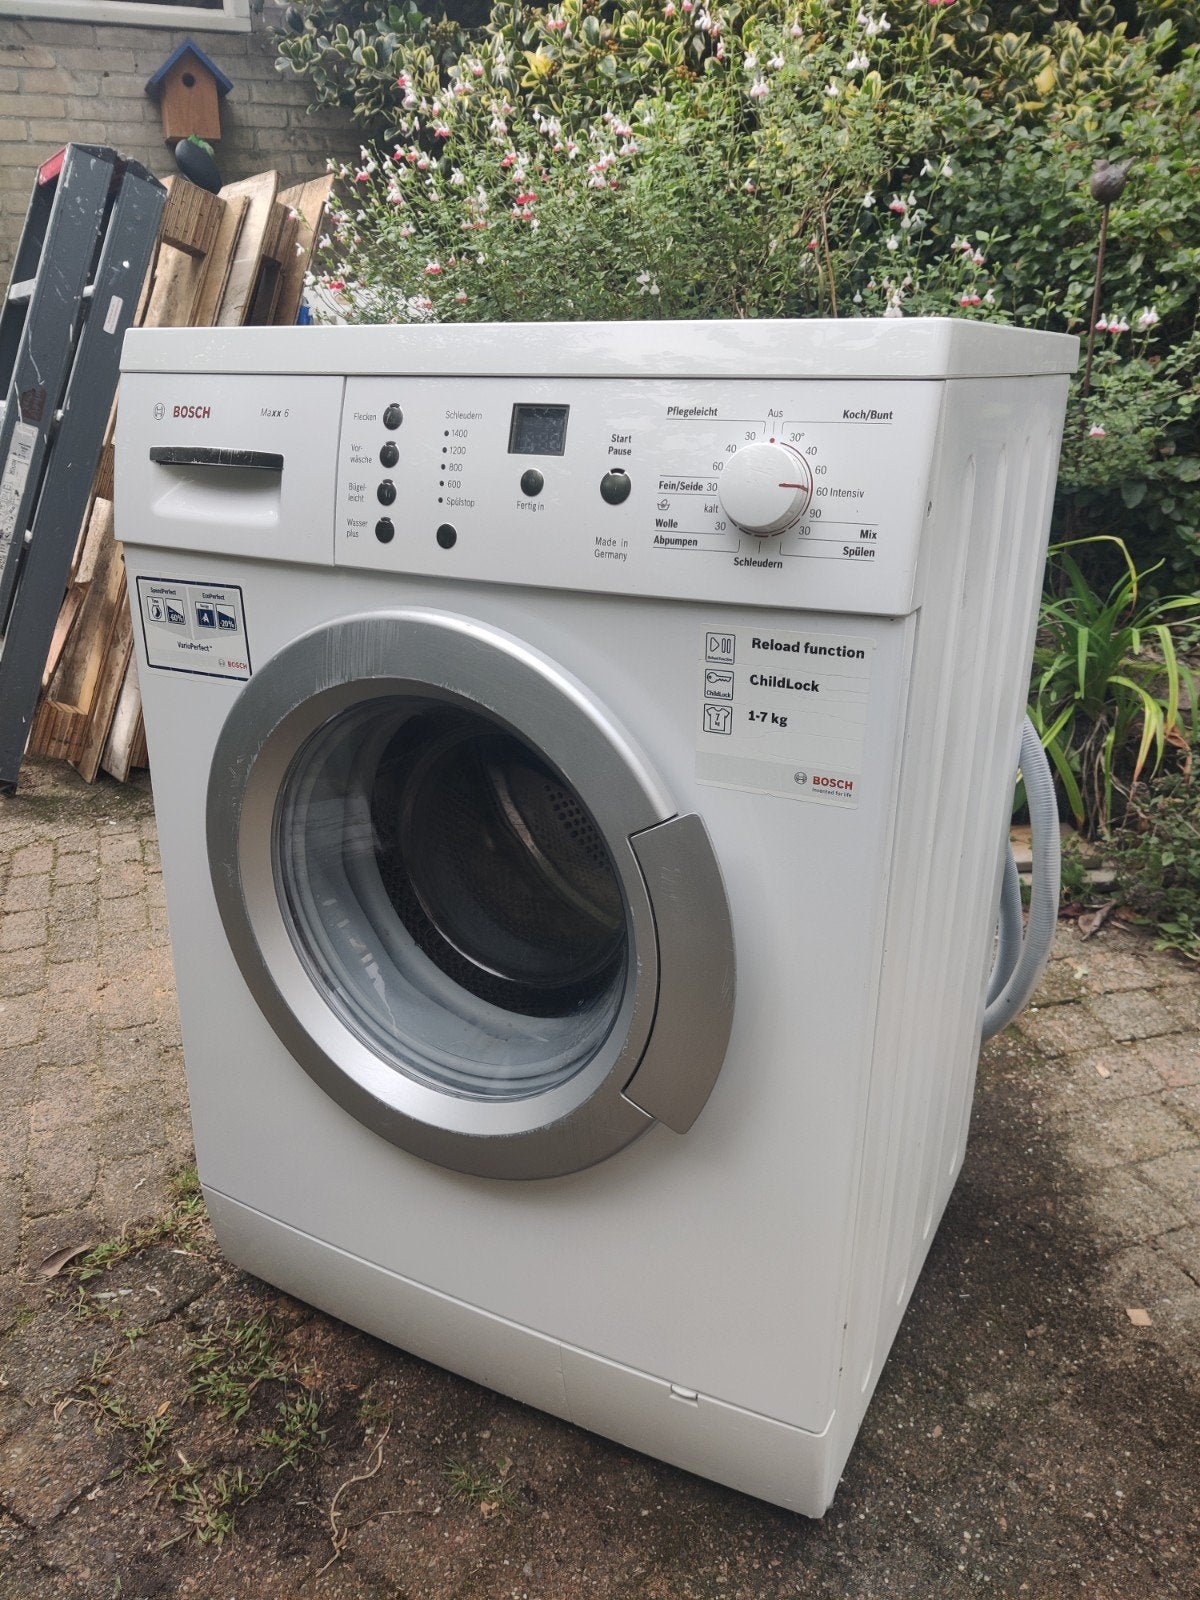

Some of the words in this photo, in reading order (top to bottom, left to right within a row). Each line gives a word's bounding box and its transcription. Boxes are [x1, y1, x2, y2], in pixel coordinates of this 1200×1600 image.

[172, 405, 211, 419] BOSCH
[260, 407, 282, 417] Maxx
[284, 408, 290, 417] 6
[353, 412, 377, 421] Flecken
[445, 410, 483, 420] Schleudern
[667, 406, 718, 418] Pflegeleicht
[767, 408, 783, 418] Aus
[842, 409, 893, 420] Koch/Bunt
[452, 429, 468, 438] 1400
[611, 433, 632, 443] Start
[744, 431, 756, 441] 30
[450, 446, 466, 455] 1200
[608, 446, 632, 456] Pause
[725, 444, 737, 453] 40
[805, 446, 818, 456] 40
[448, 463, 463, 472] 800
[712, 461, 724, 471] 60
[814, 465, 827, 475] 60
[447, 480, 462, 489] 600
[658, 480, 703, 492] Fein/Seide
[706, 482, 718, 492] 30
[816, 487, 828, 497] 60
[829, 487, 865, 499] Intensiv
[446, 496, 475, 508] Spülstop
[516, 500, 537, 513] Fertig
[537, 501, 545, 511] in
[704, 504, 719, 513] kalt
[809, 508, 822, 518] 90
[346, 518, 368, 527] Wasser
[655, 518, 679, 529] Wolle
[714, 521, 726, 531] 30
[346, 529, 359, 538] plus
[798, 526, 811, 536] 30
[859, 529, 877, 540] Mix
[595, 536, 617, 547] Made
[620, 537, 628, 548] in
[653, 535, 698, 547] Abpumpen
[594, 548, 628, 562] Germany
[842, 546, 875, 558] Spülen
[733, 556, 783, 569] Schleudern
[201, 612, 210, 623] A
[751, 637, 801, 653] Reload
[803, 641, 865, 660] function
[227, 660, 248, 670] BOSCH
[749, 673, 820, 693] ChildLock
[715, 713, 720, 721] 7
[748, 710, 768, 722] 1-7
[771, 712, 788, 727] kg
[812, 775, 853, 791] BOSCH
